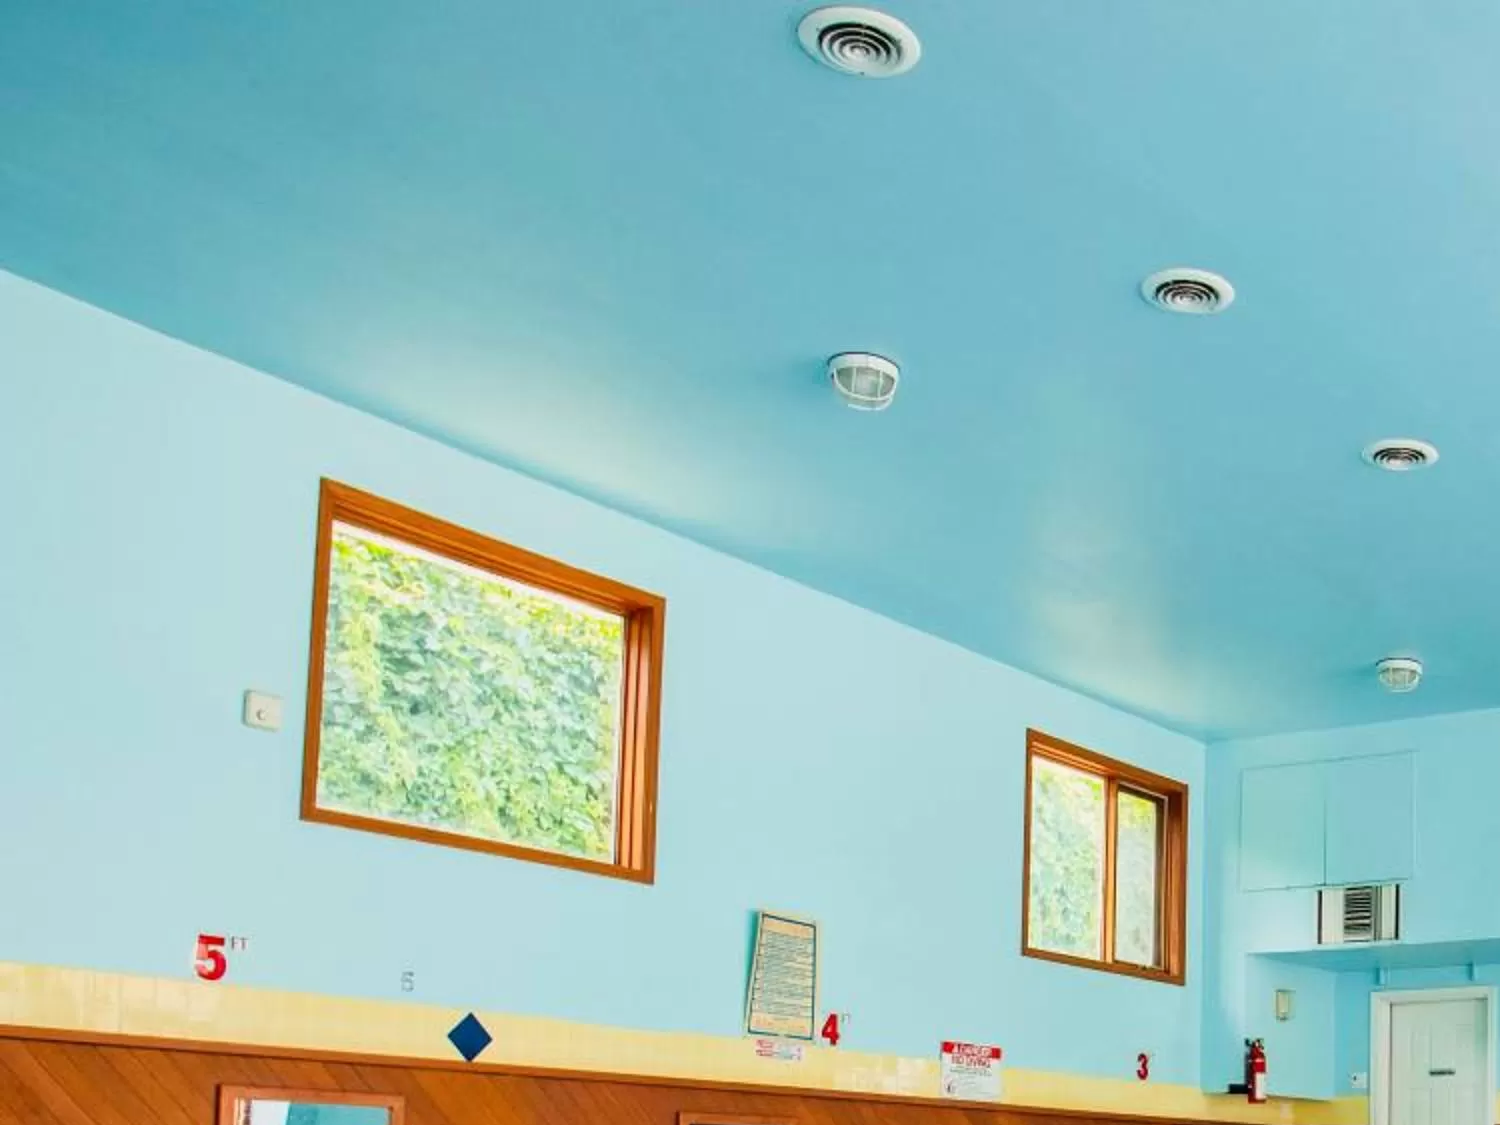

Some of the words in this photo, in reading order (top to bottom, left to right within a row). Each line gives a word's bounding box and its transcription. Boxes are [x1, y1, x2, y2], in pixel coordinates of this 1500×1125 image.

[195, 934, 227, 981] 5
[231, 935, 249, 951] FT
[821, 1013, 841, 1046] 4
[1136, 1053, 1149, 1081] 3
